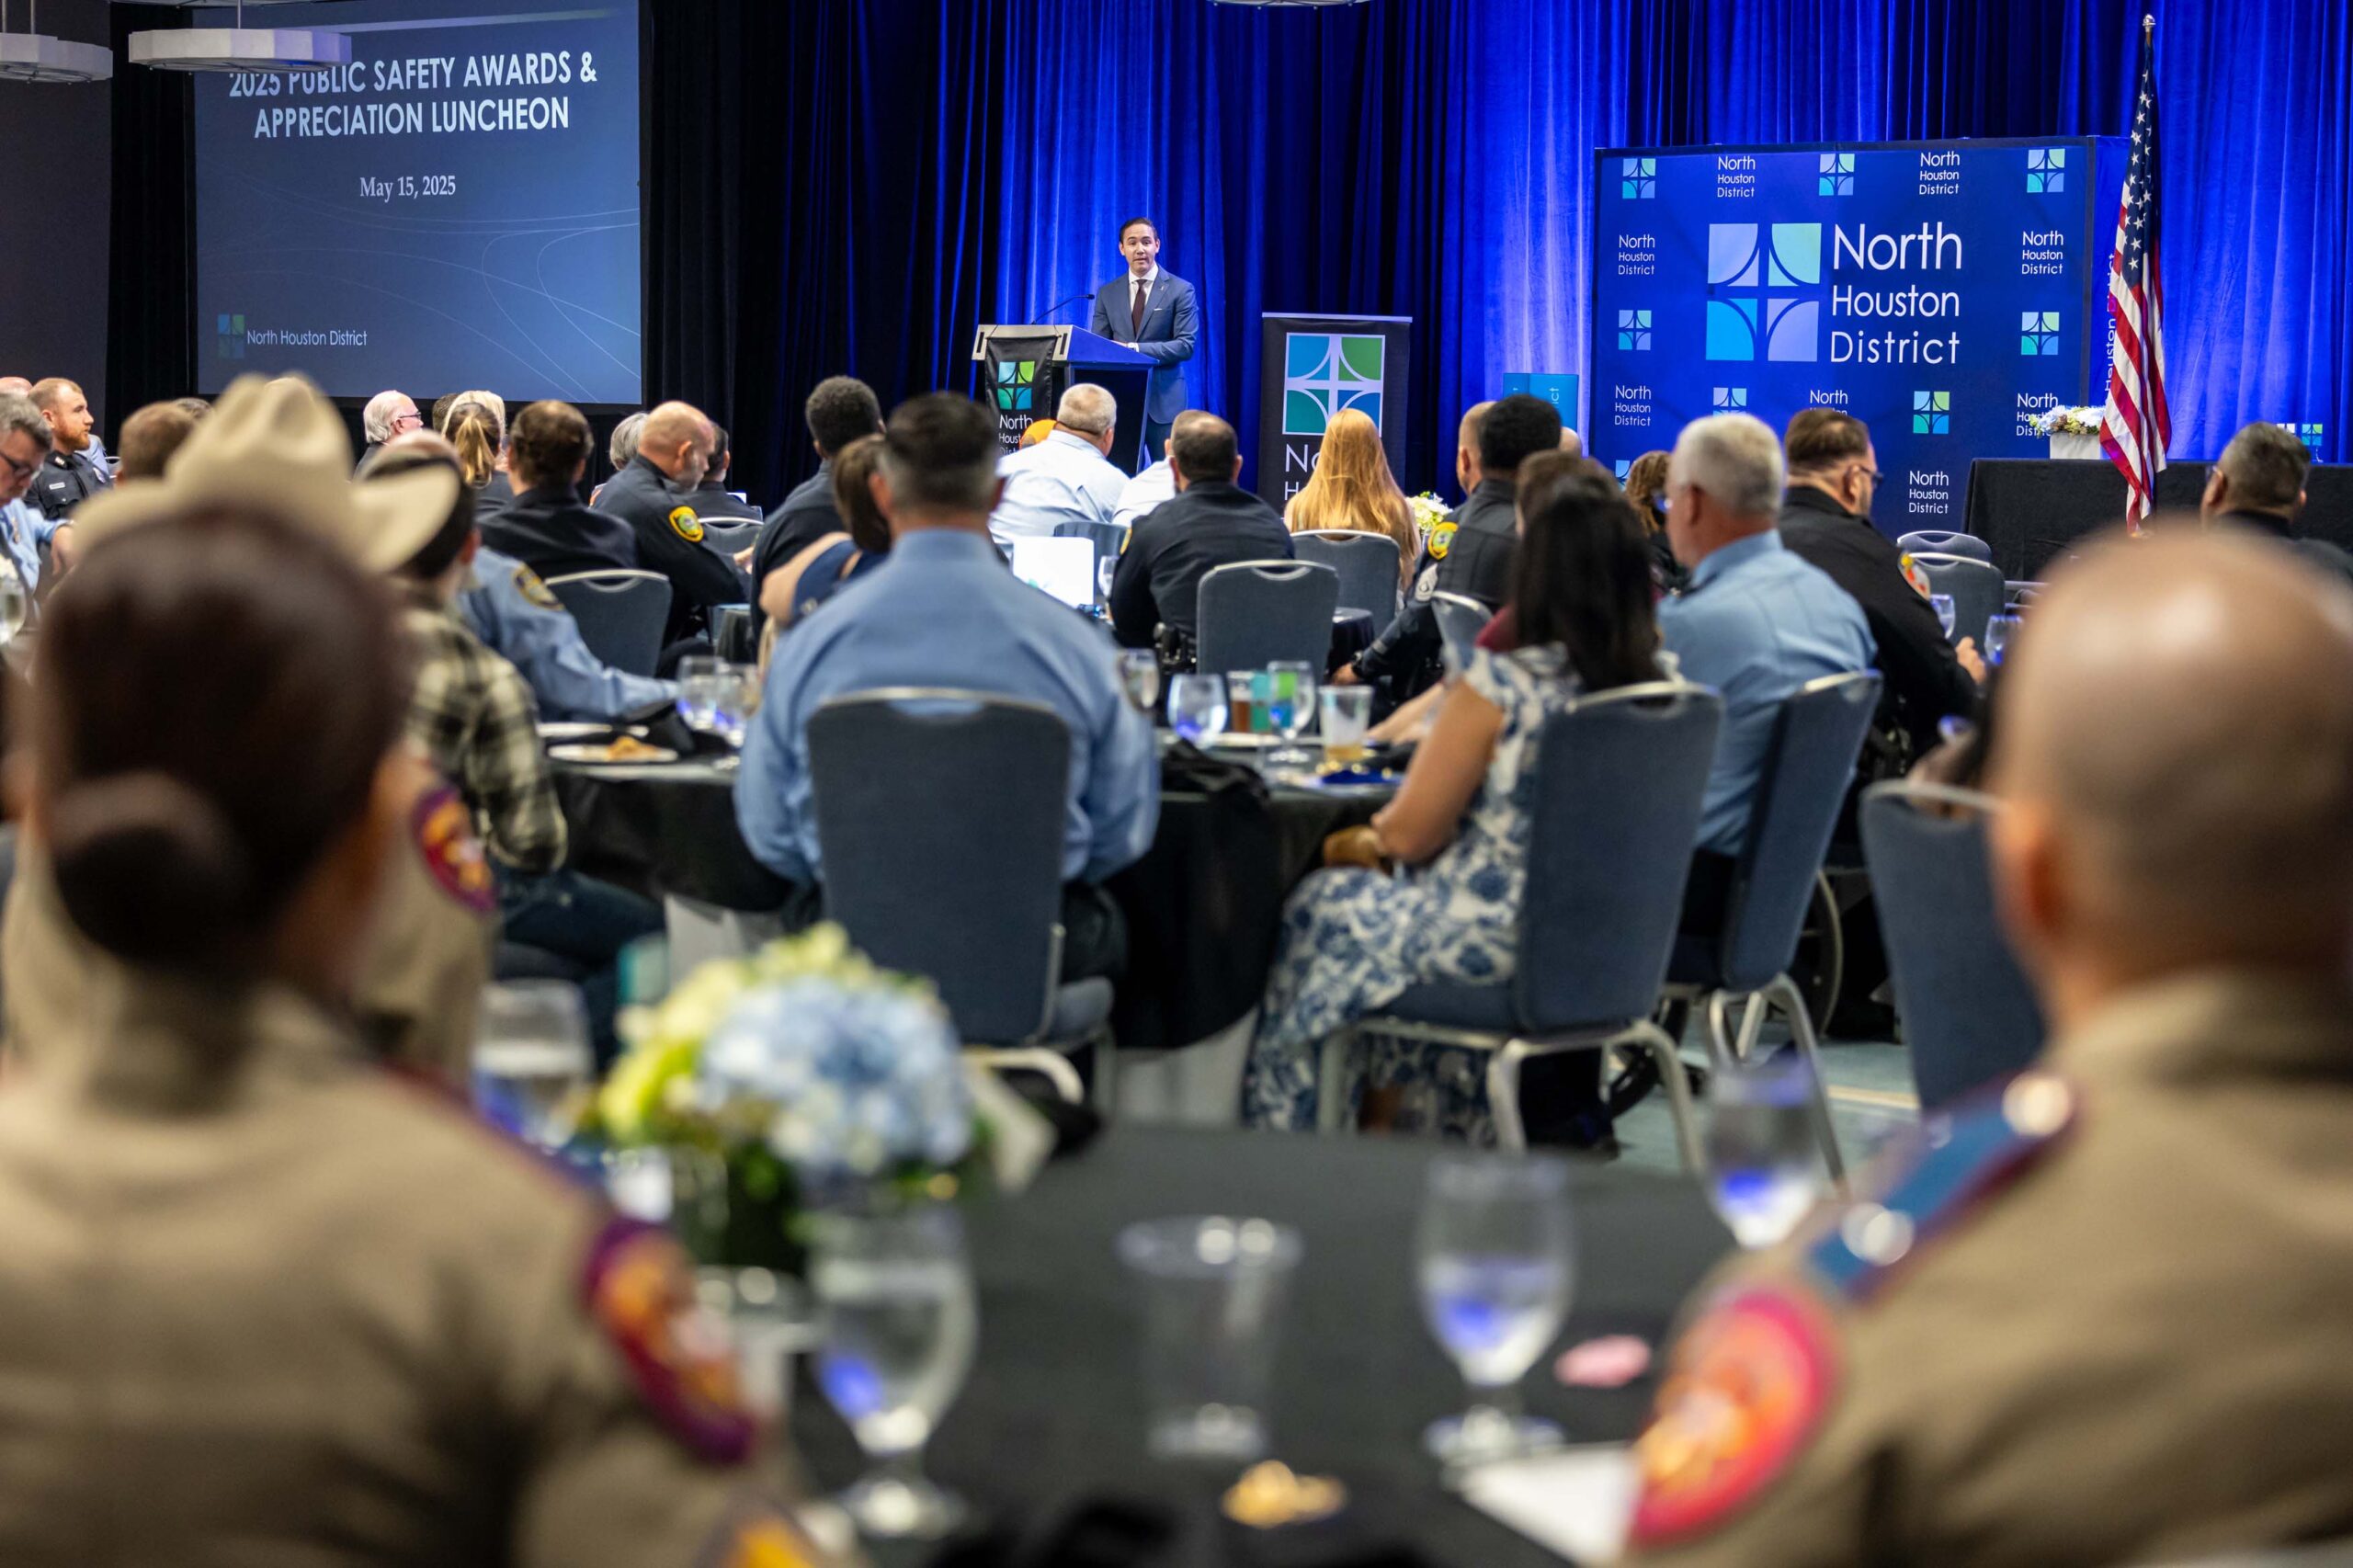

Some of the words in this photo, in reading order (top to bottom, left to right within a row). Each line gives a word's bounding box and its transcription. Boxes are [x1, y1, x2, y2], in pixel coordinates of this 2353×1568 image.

[229, 73, 281, 97] 2025
[289, 61, 366, 95] PUBLIC
[374, 57, 456, 91] SAFETY
[463, 51, 571, 86] AWARDS
[580, 51, 597, 83] &
[255, 103, 423, 138] APPRECIATION
[432, 97, 569, 131] LUNCHEON
[1718, 155, 1756, 171] North
[1920, 151, 1960, 166] North
[1718, 173, 1755, 185] Houston
[1920, 169, 1959, 181] Houston
[359, 177, 393, 202] May
[398, 176, 418, 199] 15,
[423, 175, 456, 196] 2025
[1717, 187, 1755, 198] District
[1919, 183, 1959, 195] District
[1619, 234, 1655, 248] North
[2022, 231, 2063, 246] North
[1834, 222, 1962, 270] North
[1619, 251, 1654, 262] Houston
[2022, 249, 2063, 260] Houston
[1618, 264, 1654, 276] District
[2021, 263, 2063, 275] District
[1832, 285, 1960, 317] Houston
[247, 330, 278, 346] North
[280, 330, 327, 346] Houston
[329, 330, 367, 347] District
[1830, 331, 1961, 364] District
[1615, 385, 1652, 399] North
[1809, 389, 1848, 404] North
[2017, 392, 2059, 408] North
[1615, 403, 1651, 414] Houston
[999, 414, 1033, 430] North
[1614, 415, 1651, 426] District
[998, 432, 1021, 444] Houst
[1910, 471, 1949, 486] North
[1909, 489, 1949, 500] Houston
[1908, 502, 1949, 514] District
